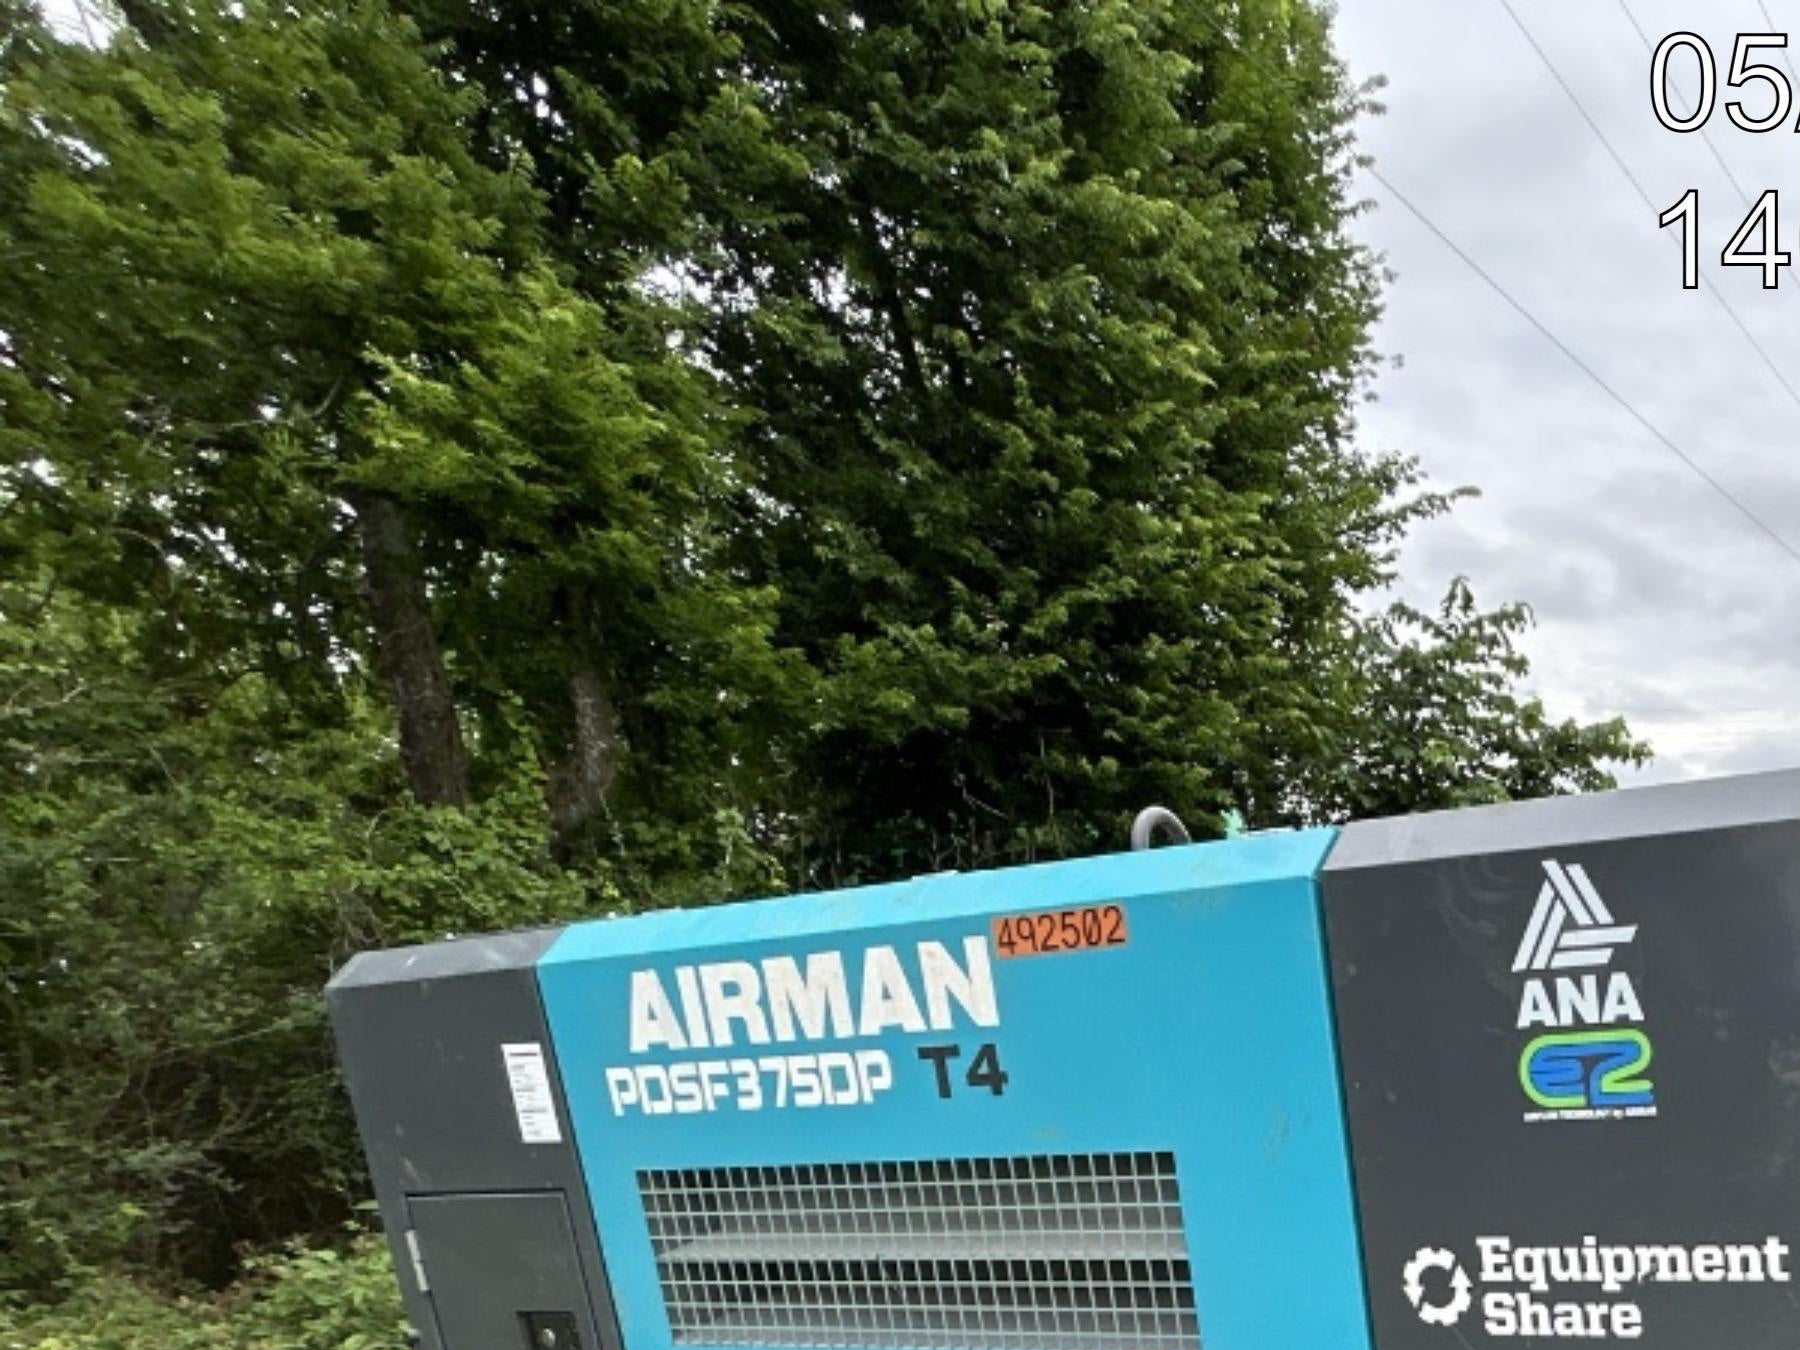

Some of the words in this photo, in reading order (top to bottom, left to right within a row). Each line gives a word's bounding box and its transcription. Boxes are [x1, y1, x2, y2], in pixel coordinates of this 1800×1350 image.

[997, 906, 1126, 955] 492502
[629, 936, 999, 1054] AIRMAN
[1517, 971, 1645, 1029] ANA
[605, 1049, 893, 1117] PDSF375DP
[917, 1043, 1009, 1099] T4
[1476, 1235, 1791, 1291] Equipment
[1482, 1292, 1643, 1338] Share
